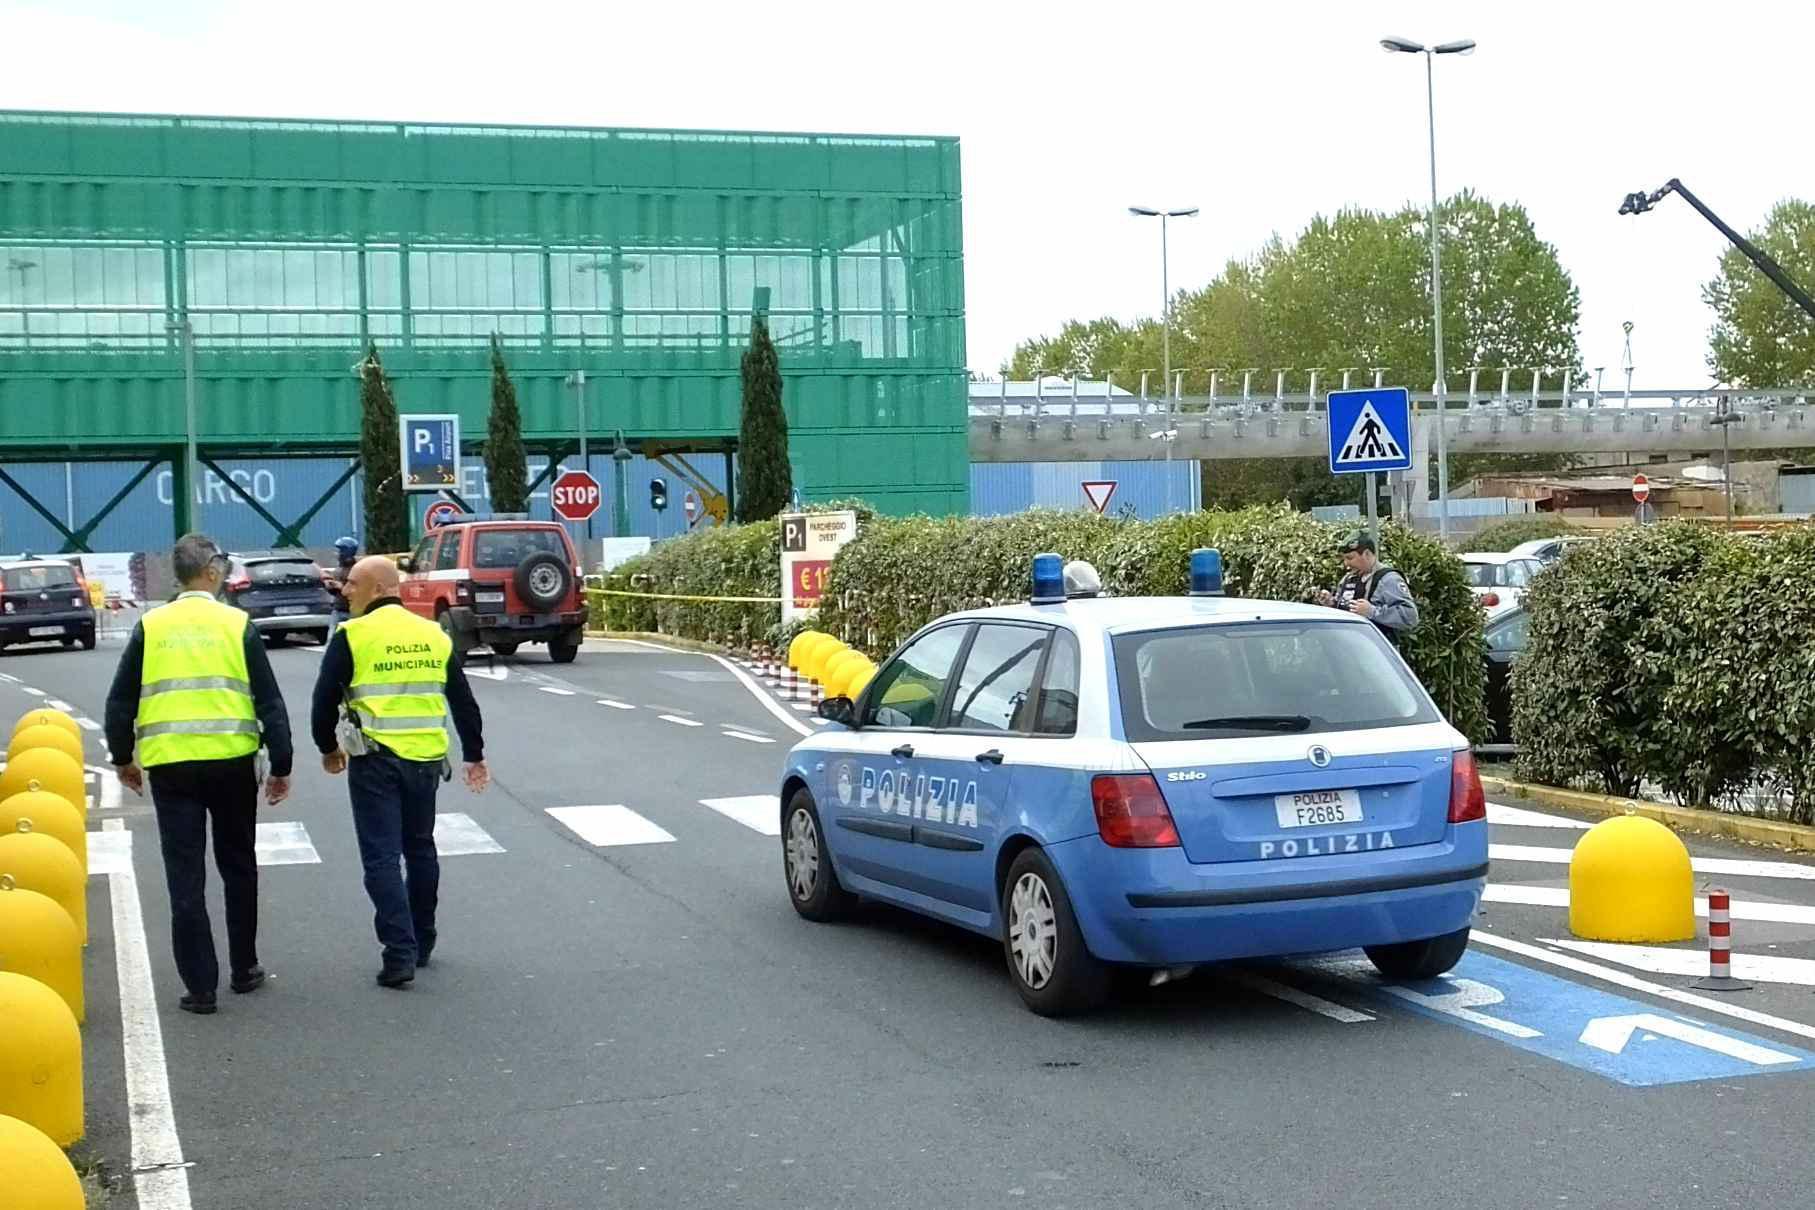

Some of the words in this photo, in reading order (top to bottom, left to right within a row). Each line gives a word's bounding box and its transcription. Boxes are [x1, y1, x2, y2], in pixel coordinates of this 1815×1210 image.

[157, 469, 275, 505] CRGO
[555, 486, 597, 505] STOP
[386, 643, 431, 655] POLIZIA
[373, 660, 442, 673] MUNICIPALE
[1167, 771, 1207, 782] Stilo
[860, 766, 978, 828] POLIZIA
[1294, 792, 1342, 807] POLIZIA
[1297, 806, 1345, 825] F2685
[1260, 831, 1395, 859] POLIZIA
